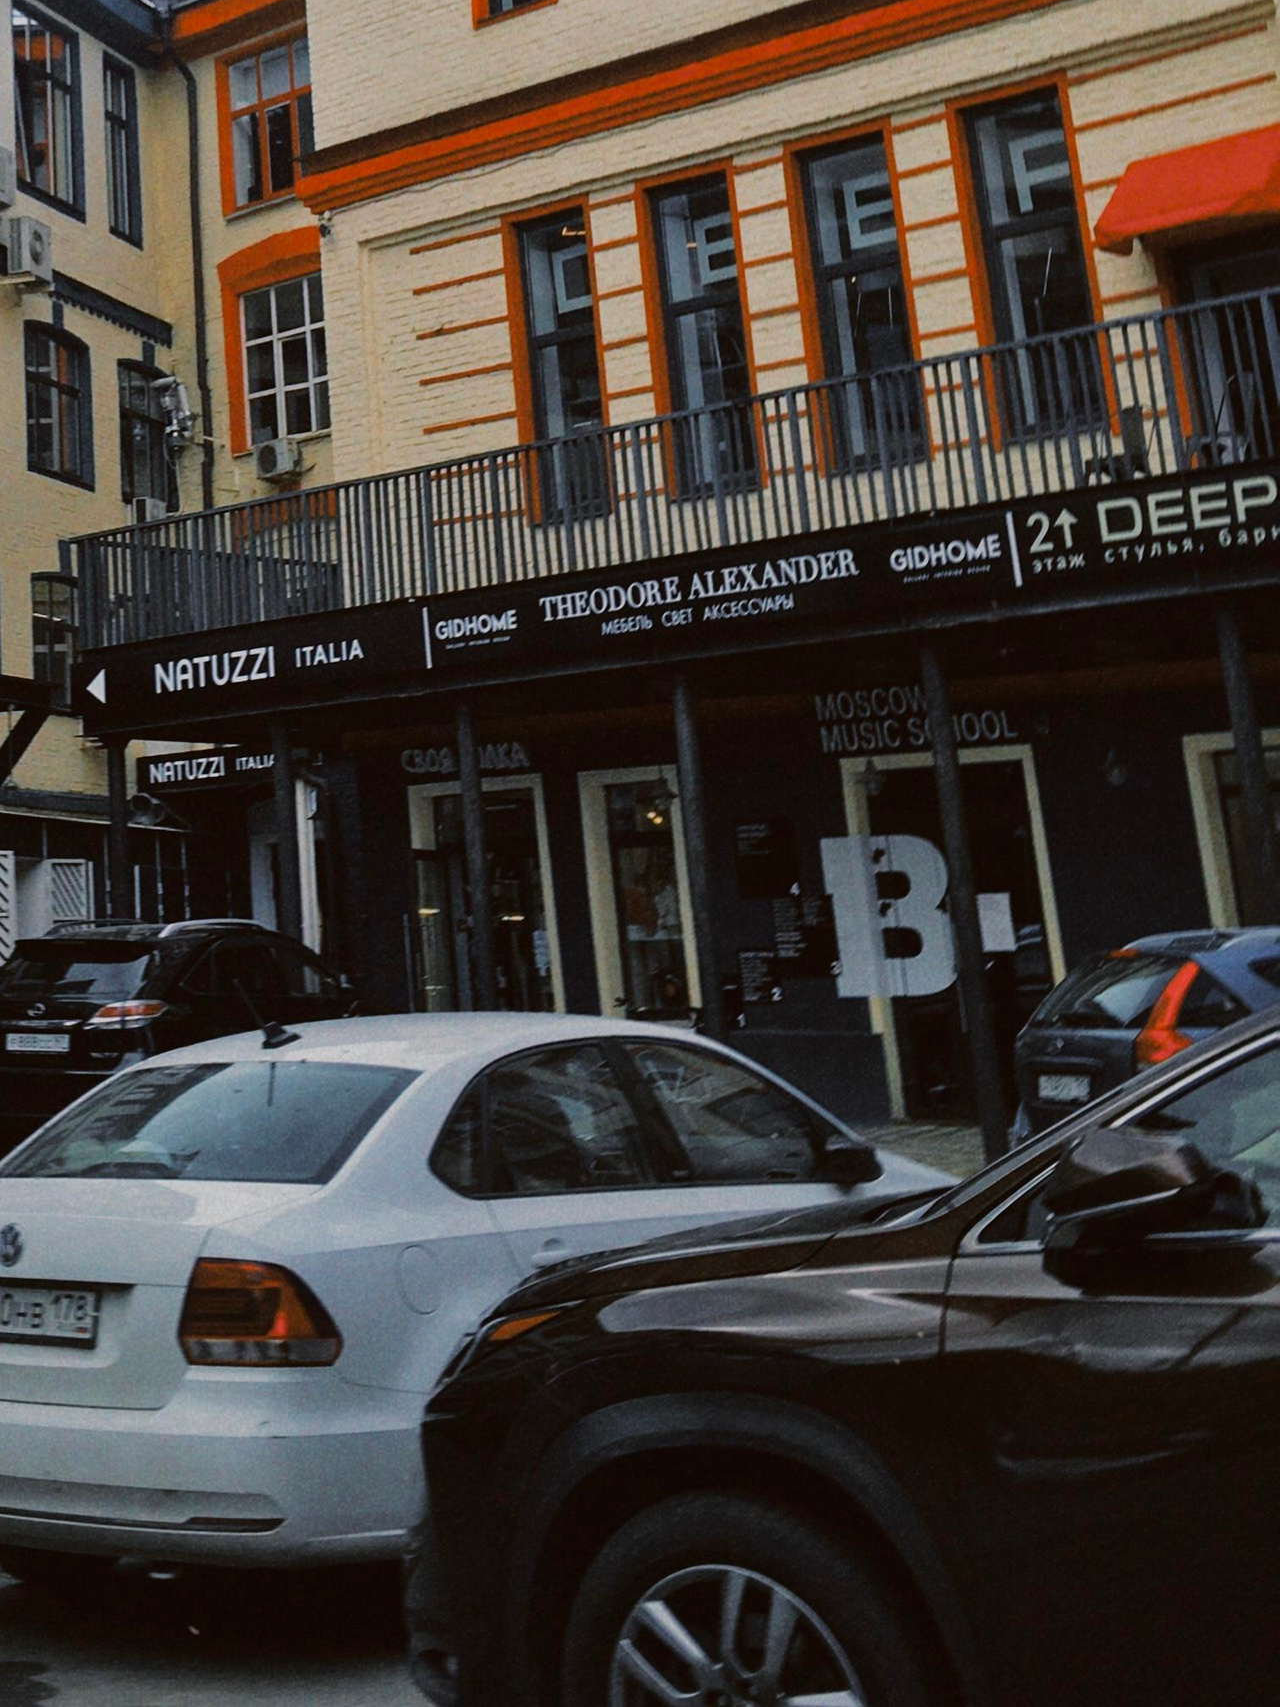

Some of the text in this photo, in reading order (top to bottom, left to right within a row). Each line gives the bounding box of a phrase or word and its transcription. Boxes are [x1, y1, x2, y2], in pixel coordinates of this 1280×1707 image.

[1096, 475, 1278, 544] DEEP
[888, 533, 1002, 574] GIDHOME
[1026, 511, 1054, 554] 2
[1104, 537, 1206, 564] стулья,
[539, 576, 683, 622] THEODORE
[688, 548, 860, 600] ALEXANDER
[1032, 553, 1086, 575] этаж
[434, 609, 518, 640] GIDHOME
[601, 593, 795, 637] МЕБЕЛЬ СВЕТ АКСЕССУАРЫ
[154, 638, 365, 695] NATUZZI ITALIA
[819, 719, 902, 753] MUSIC
[149, 755, 226, 784] NATUZZI
[819, 834, 959, 999] B
